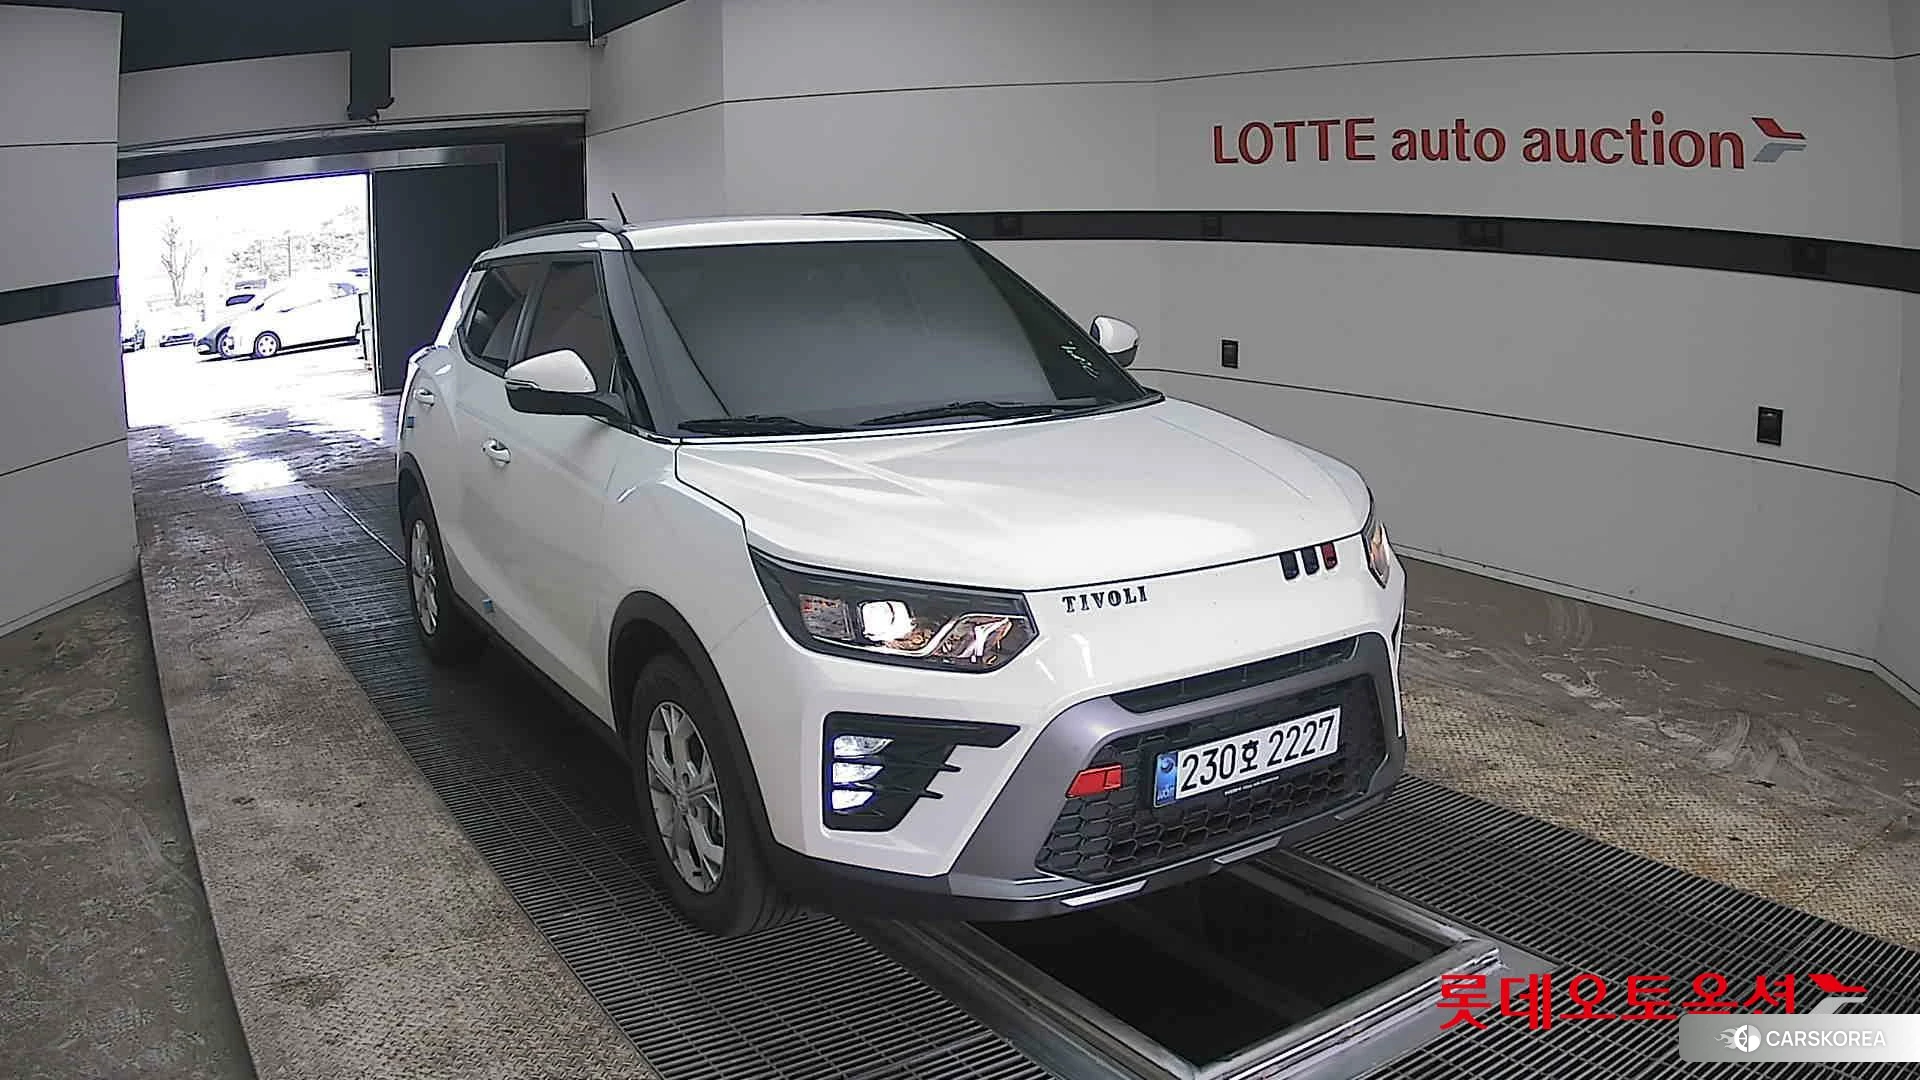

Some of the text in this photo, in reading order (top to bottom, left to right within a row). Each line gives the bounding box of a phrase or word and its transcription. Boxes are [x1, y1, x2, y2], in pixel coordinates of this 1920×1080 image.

[1213, 110, 1746, 170] LOTTE auto auction
[1062, 585, 1148, 613] TIVOLI
[1180, 715, 1335, 793] 230호 2227
